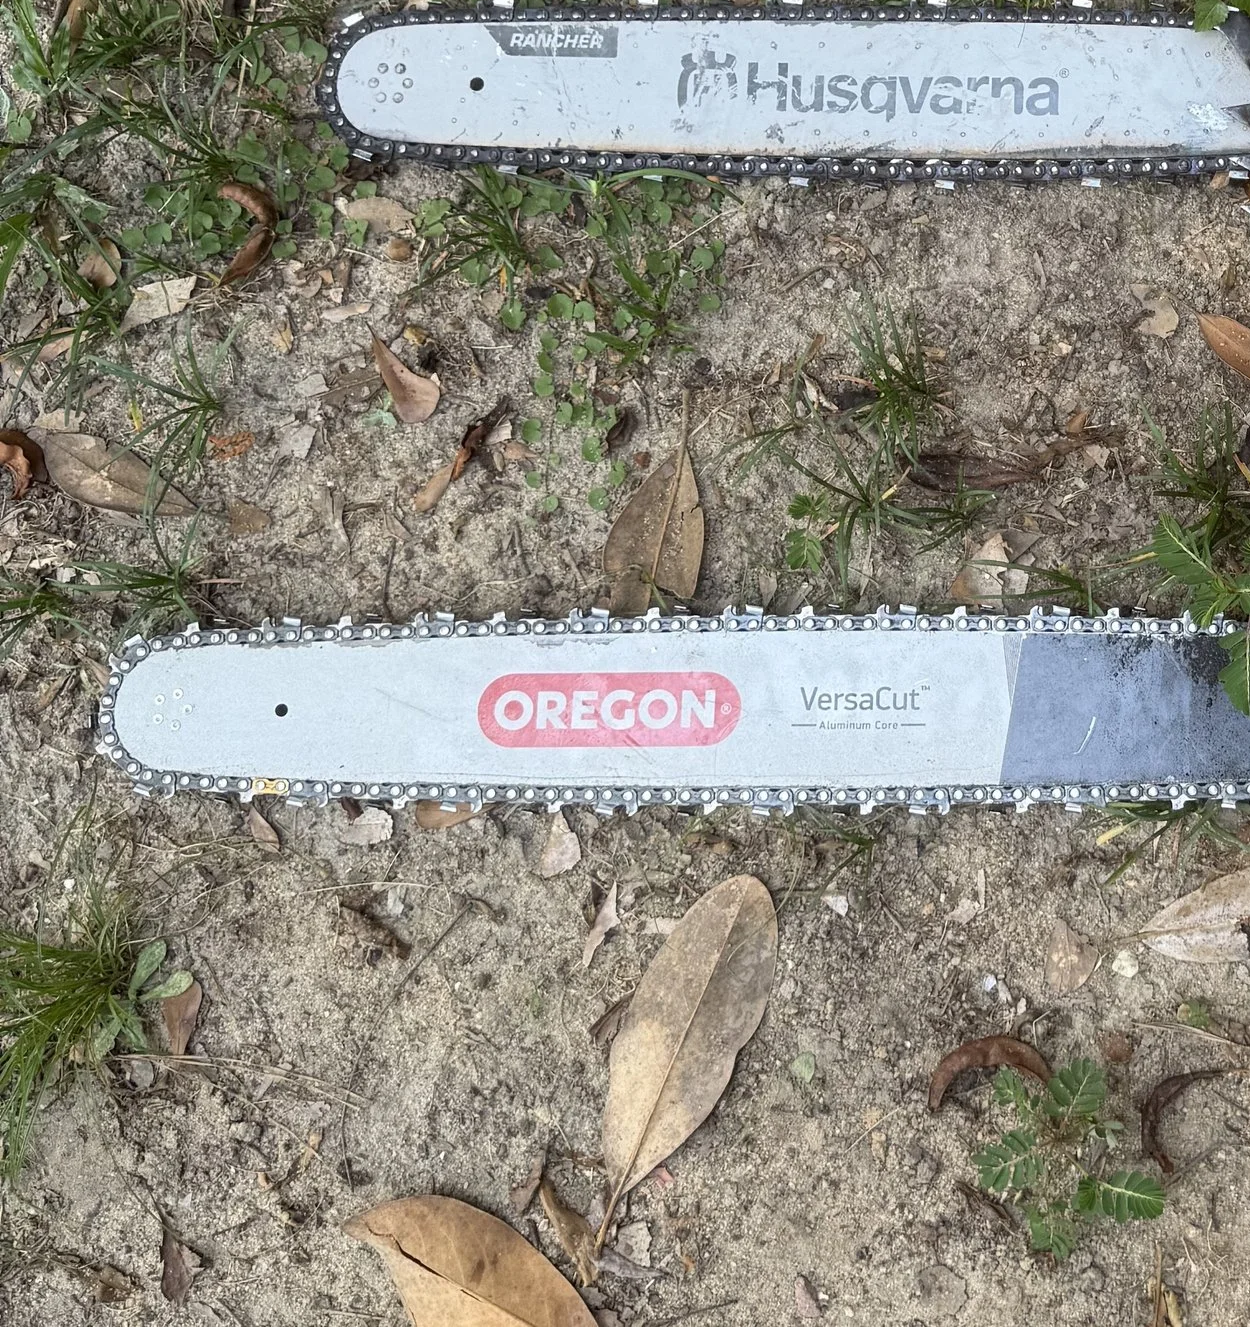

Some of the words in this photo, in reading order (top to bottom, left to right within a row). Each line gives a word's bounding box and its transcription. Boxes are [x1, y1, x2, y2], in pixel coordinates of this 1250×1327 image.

[509, 32, 604, 49] RANCHER
[819, 721, 871, 730] Aluminum
[875, 721, 898, 730] Core
